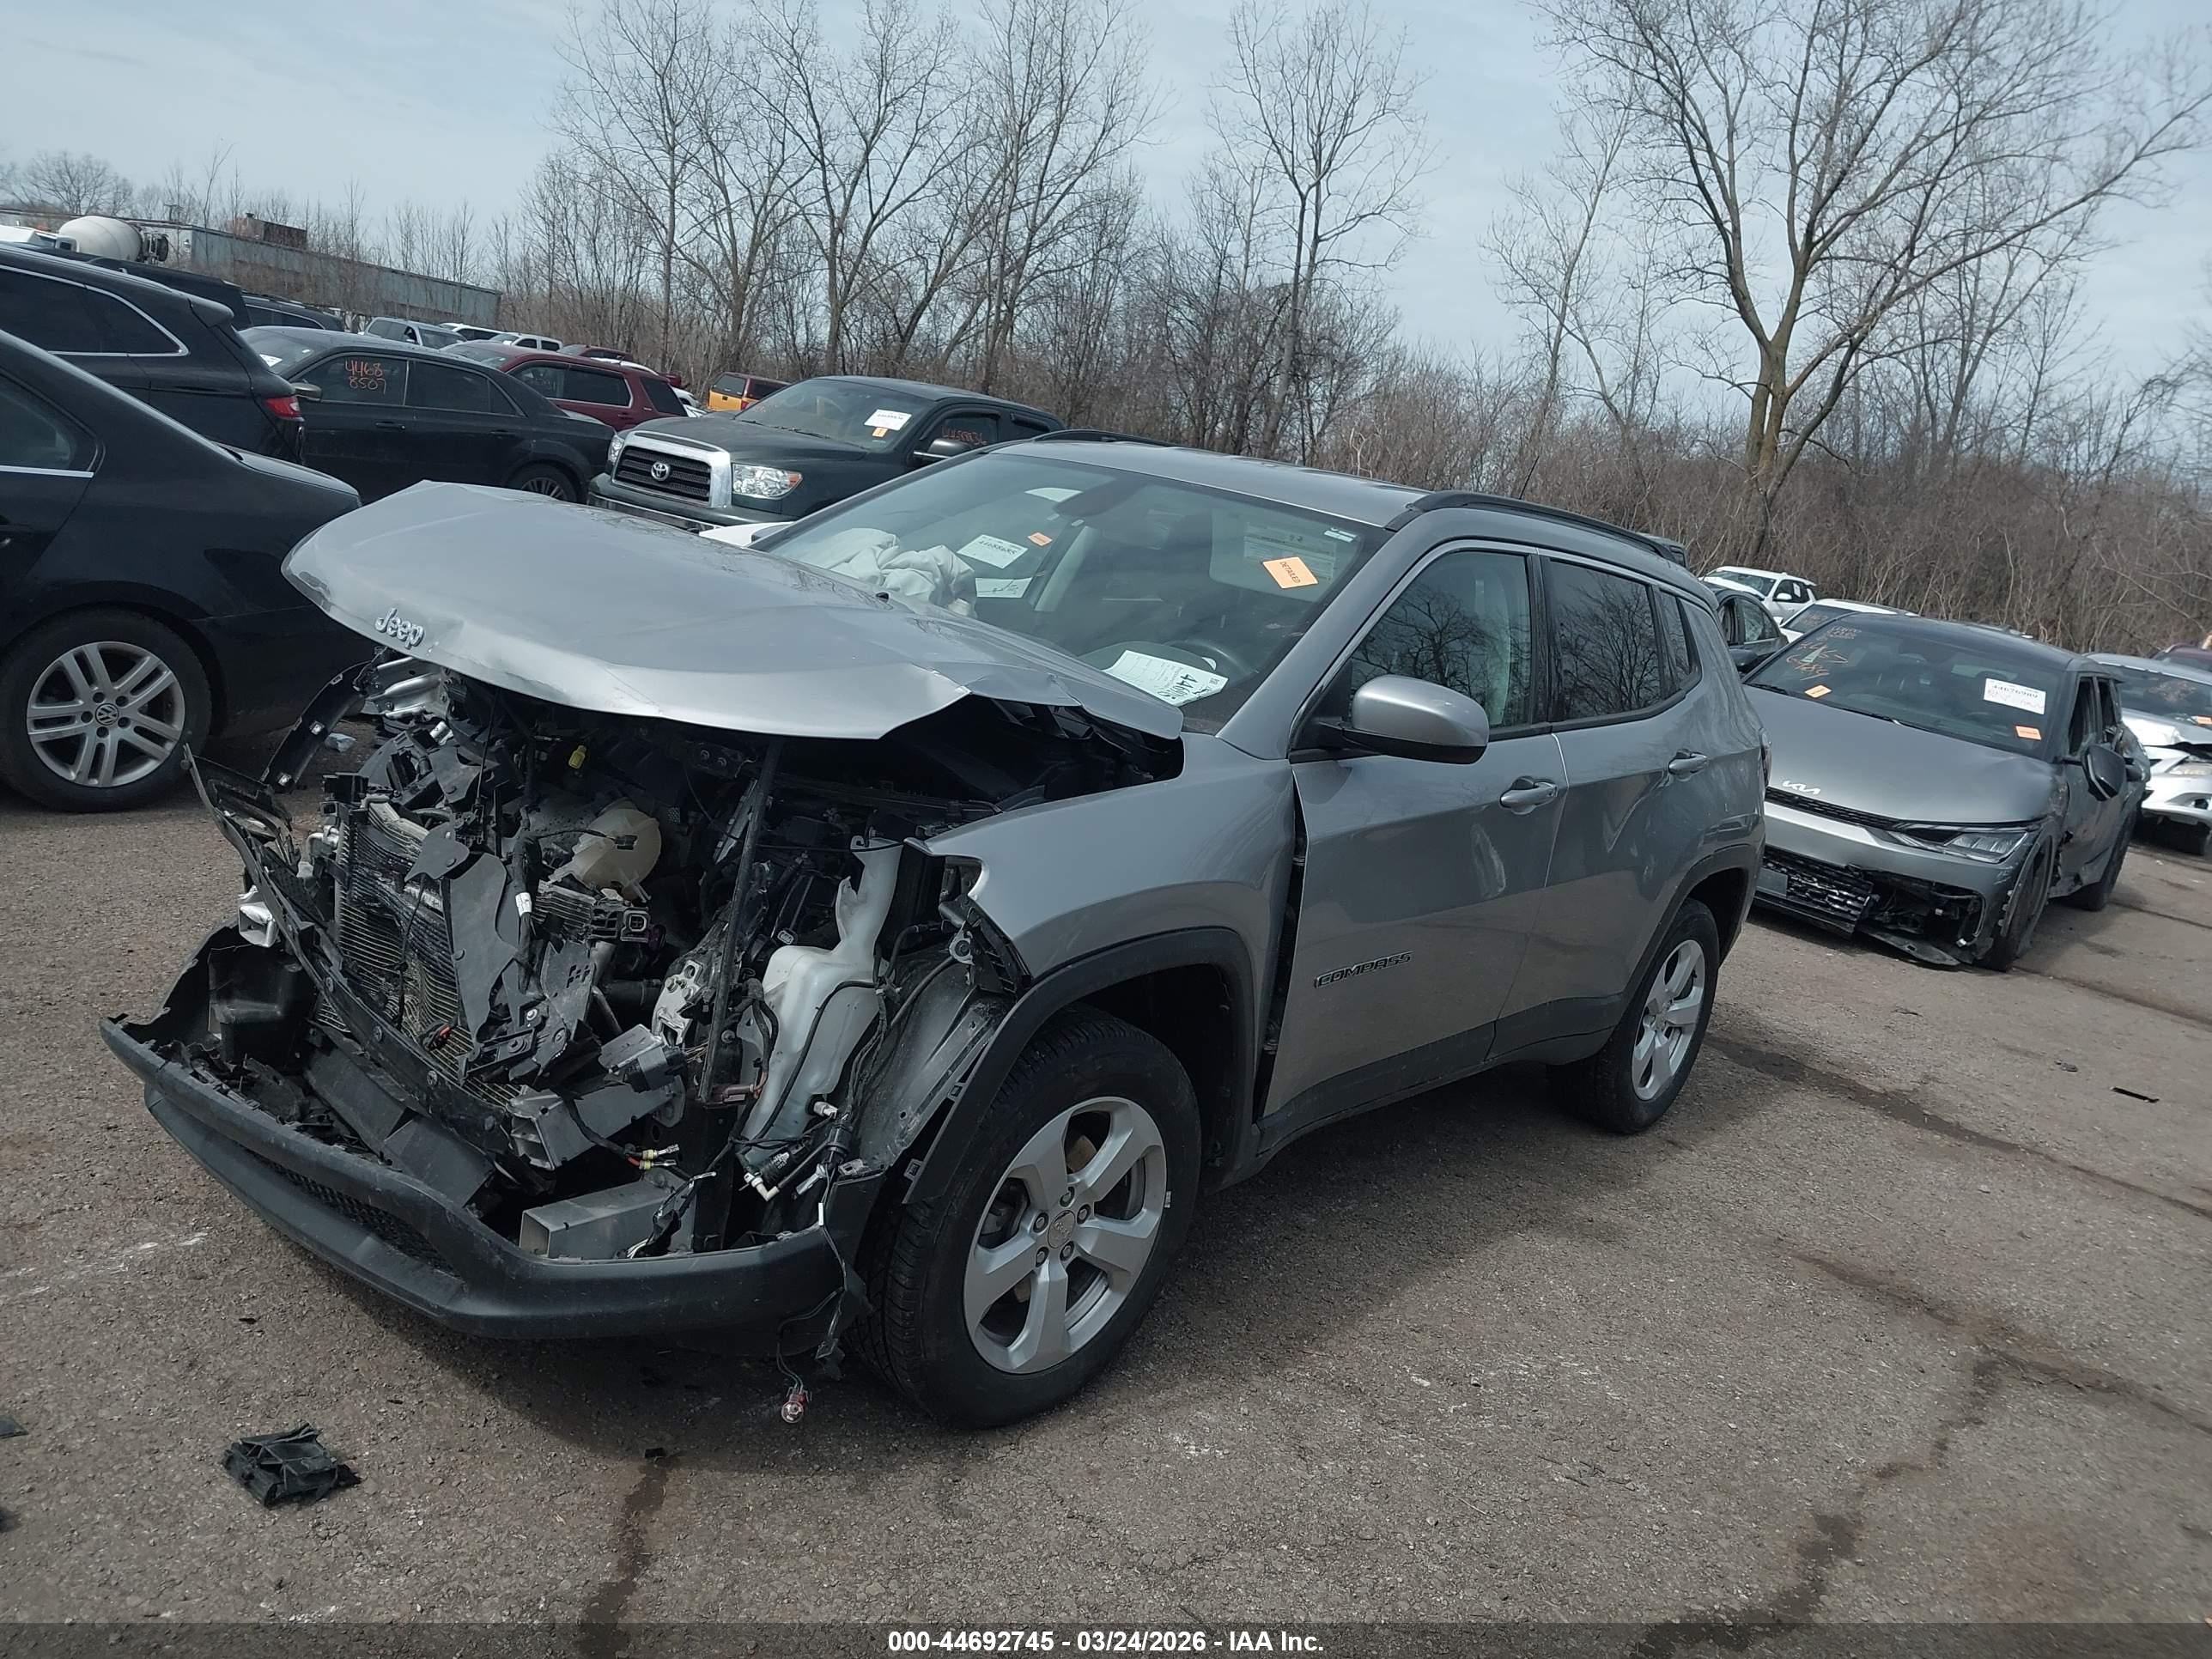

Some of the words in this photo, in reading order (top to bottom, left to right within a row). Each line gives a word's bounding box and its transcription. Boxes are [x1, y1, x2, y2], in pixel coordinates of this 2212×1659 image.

[344, 360, 383, 377] 4468
[349, 376, 386, 394] 8507
[1279, 560, 1302, 585] DETAILED
[375, 607, 425, 650] Jeep
[1314, 950, 1413, 988] COMPASS
